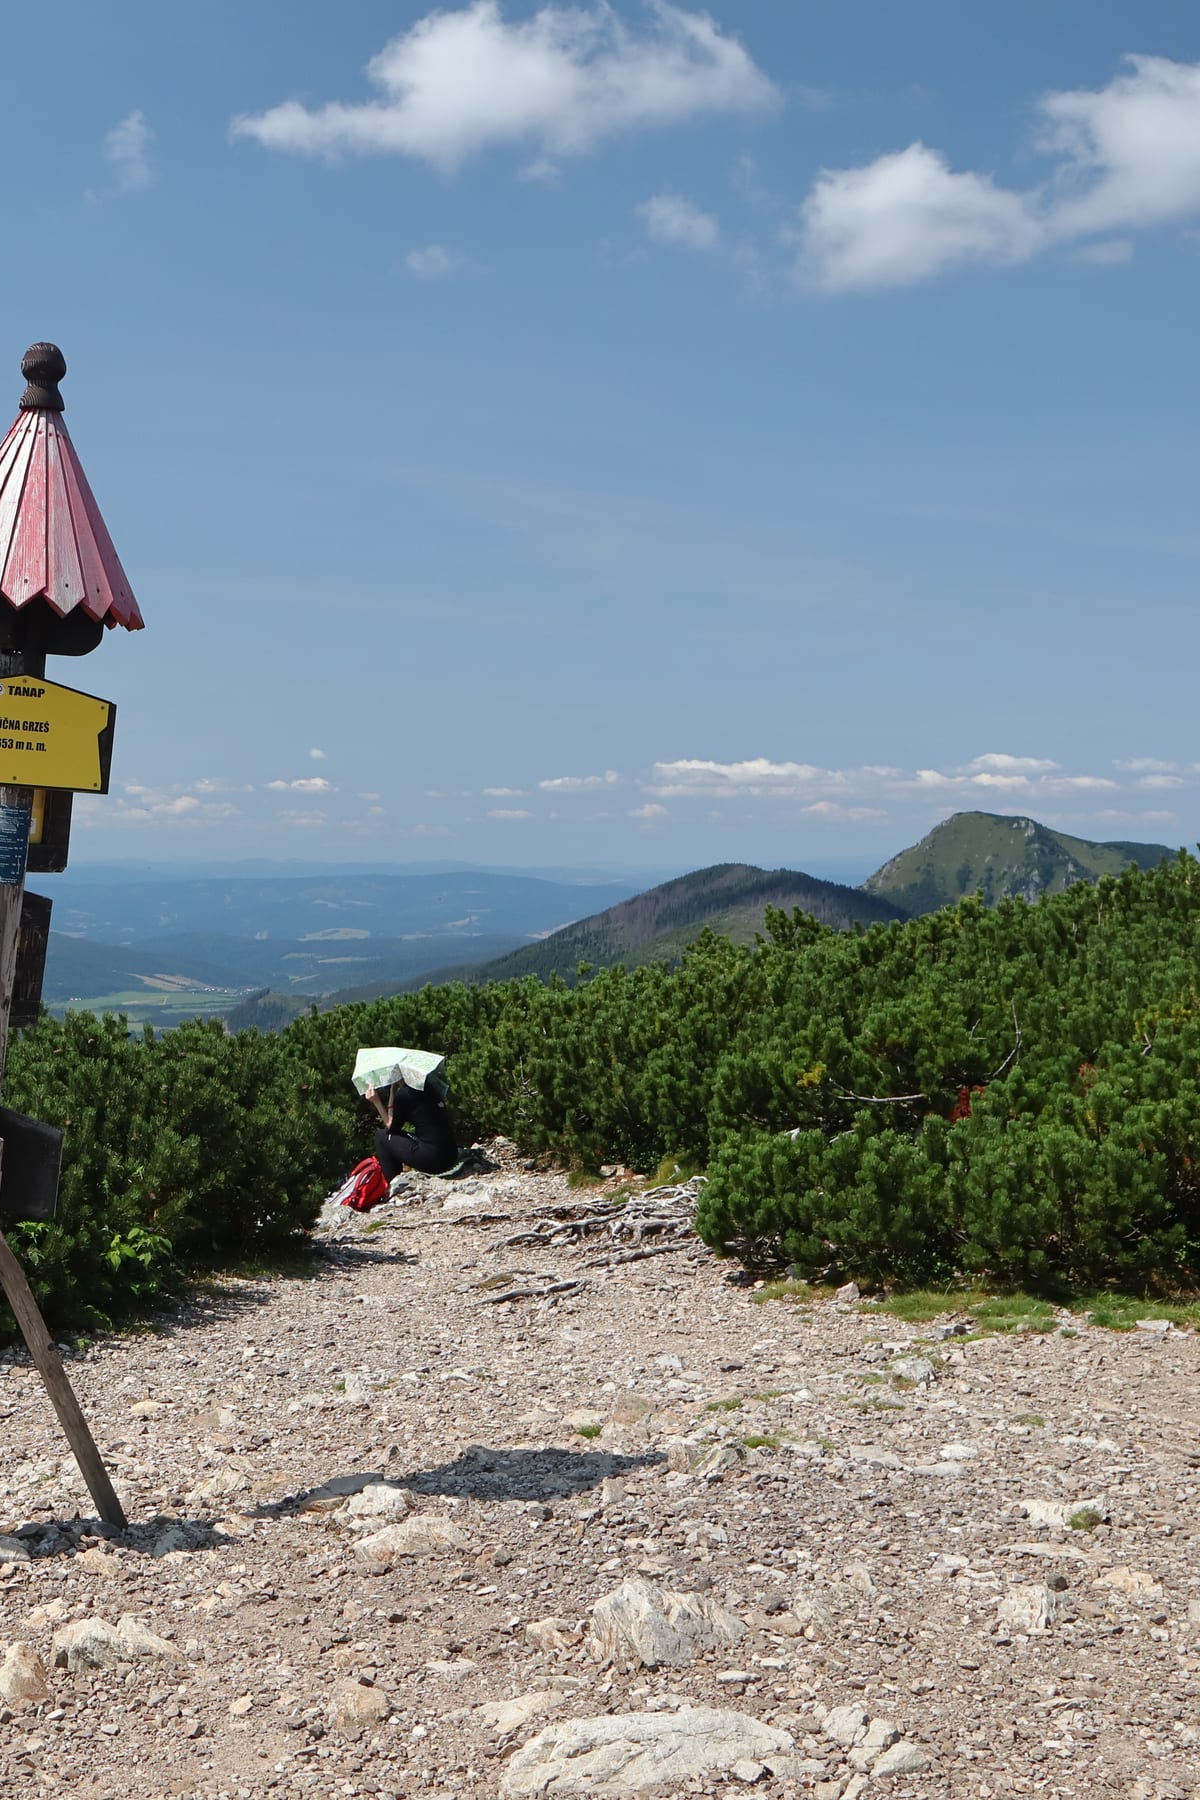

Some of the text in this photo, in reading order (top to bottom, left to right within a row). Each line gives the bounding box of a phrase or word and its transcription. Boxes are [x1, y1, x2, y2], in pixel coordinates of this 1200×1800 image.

[8, 685, 45, 698] TANAP
[22, 720, 50, 733] GRZEŚ
[16, 740, 24, 750] m
[26, 742, 34, 751] n.
[36, 742, 47, 752] m.
